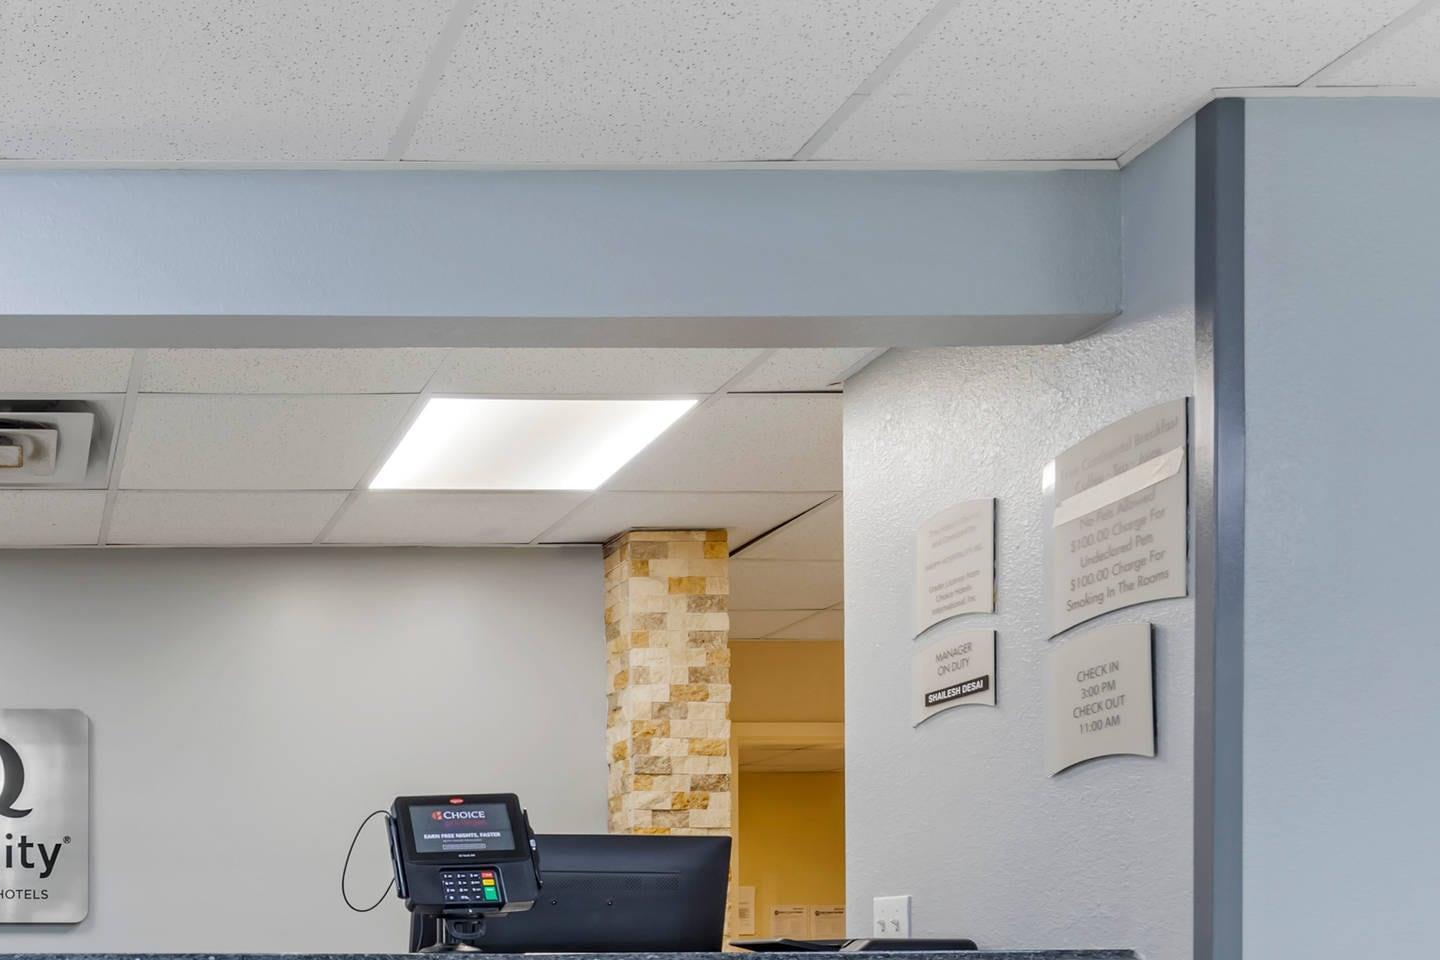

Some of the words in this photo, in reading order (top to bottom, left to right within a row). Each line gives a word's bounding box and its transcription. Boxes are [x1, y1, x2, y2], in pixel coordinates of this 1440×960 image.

[1112, 515, 1148, 537] Charge
[1150, 507, 1167, 522] For
[1079, 534, 1134, 569] Undeclared
[1070, 566, 1110, 592] $100.00
[1112, 556, 1148, 576] Charge
[1149, 549, 1167, 563] For
[1066, 590, 1105, 612] Smoking
[1106, 585, 1116, 599] In
[1118, 579, 1136, 593] The
[1137, 569, 1169, 589] Rooms
[936, 641, 973, 664] MANAGER
[936, 663, 951, 677] ON
[951, 656, 970, 672] DUTY
[1076, 663, 1108, 682] CHECK
[1109, 659, 1120, 673] IN
[928, 687, 961, 703] SHAILESH
[962, 680, 983, 693] DESAI
[1080, 684, 1100, 700] 3:00
[1101, 679, 1117, 693] PM
[1073, 700, 1104, 719] CHECK
[1105, 693, 1126, 710] OUT
[1080, 719, 1103, 736] 11:00
[1104, 713, 1120, 728] AM
[443, 811, 486, 820] CHOICE
